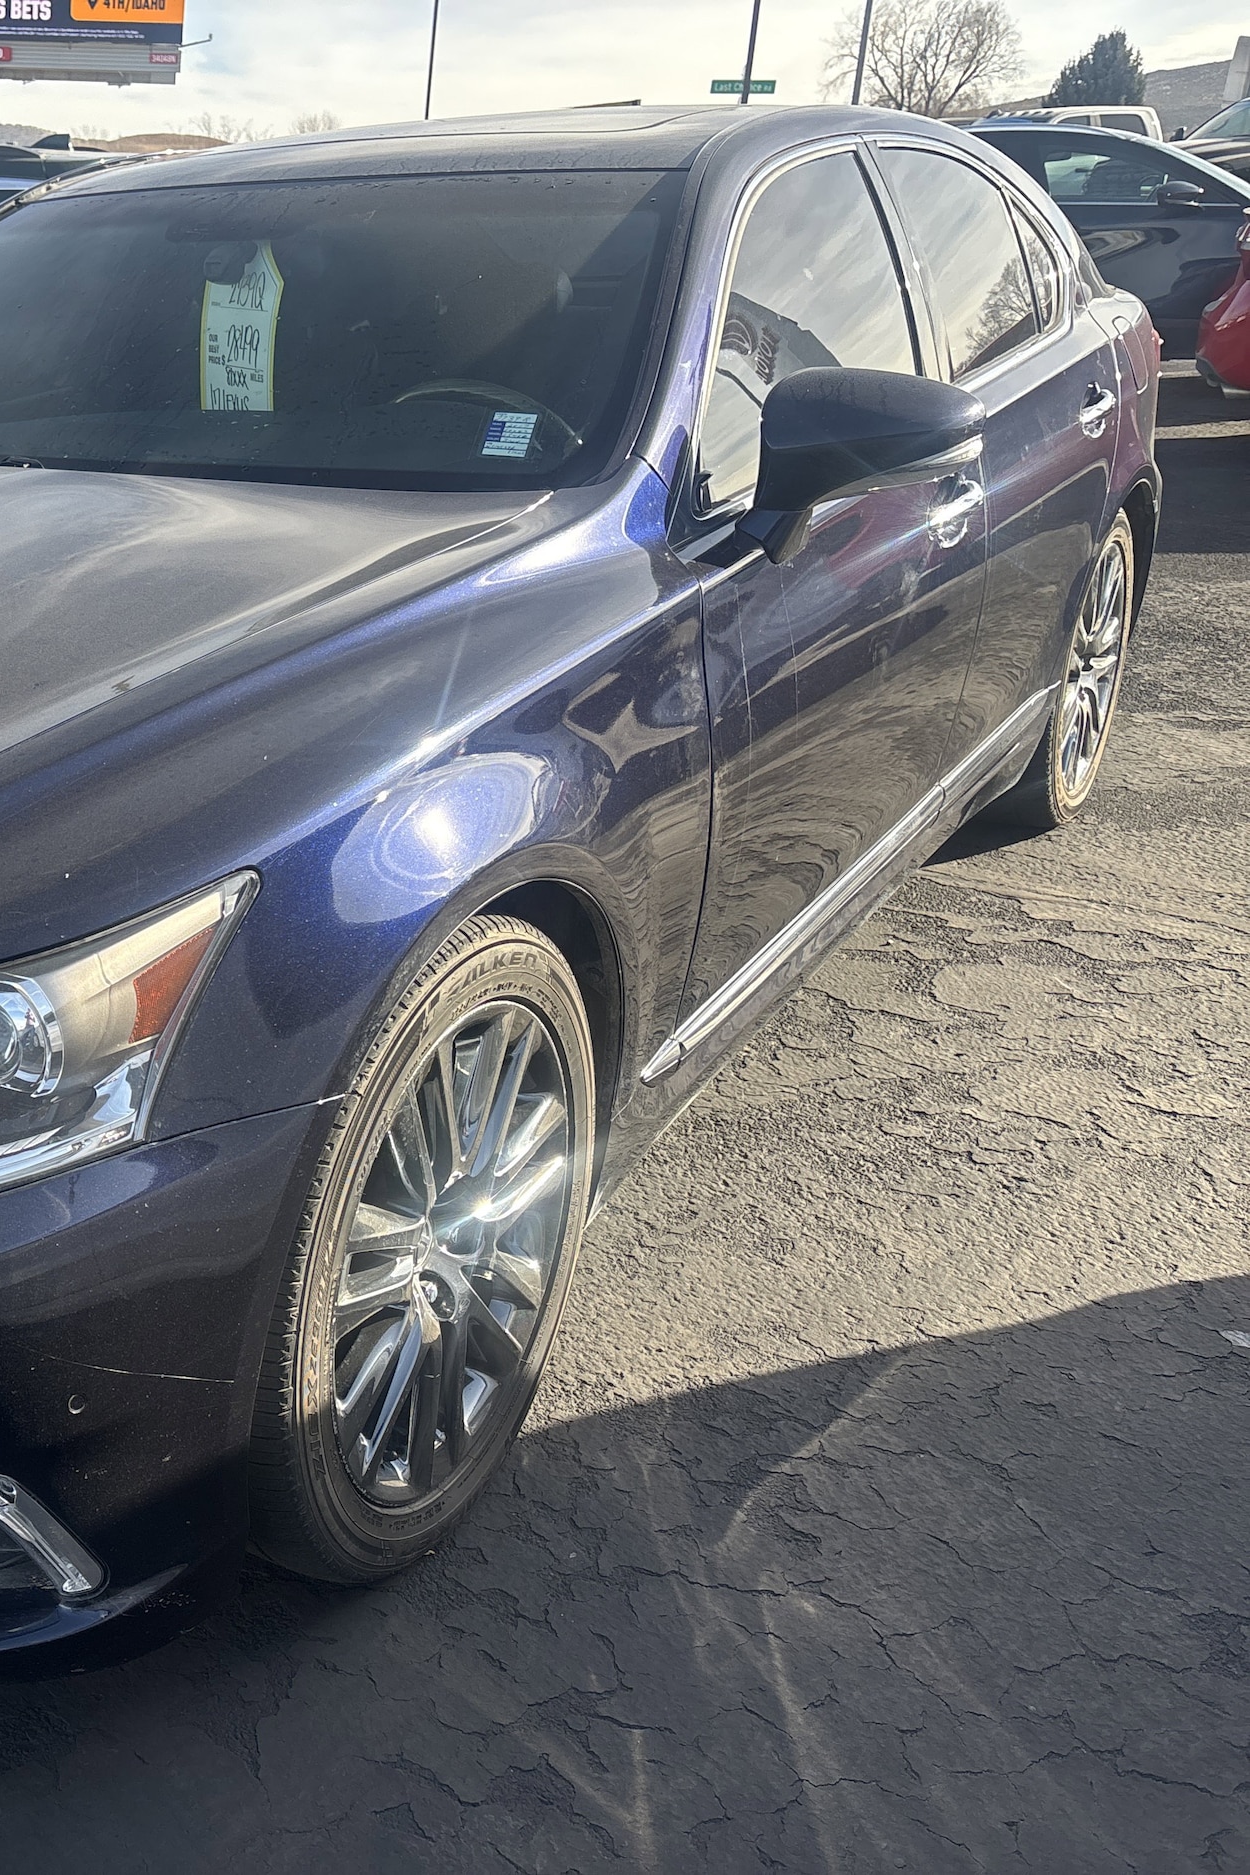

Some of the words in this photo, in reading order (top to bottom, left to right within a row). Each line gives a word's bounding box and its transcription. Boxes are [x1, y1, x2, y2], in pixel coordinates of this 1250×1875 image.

[10, 0, 52, 20] BETS
[714, 82, 732, 92] Last
[208, 334, 218, 343] OUR
[208, 345, 219, 354] BEST
[208, 356, 221, 366] PRICE
